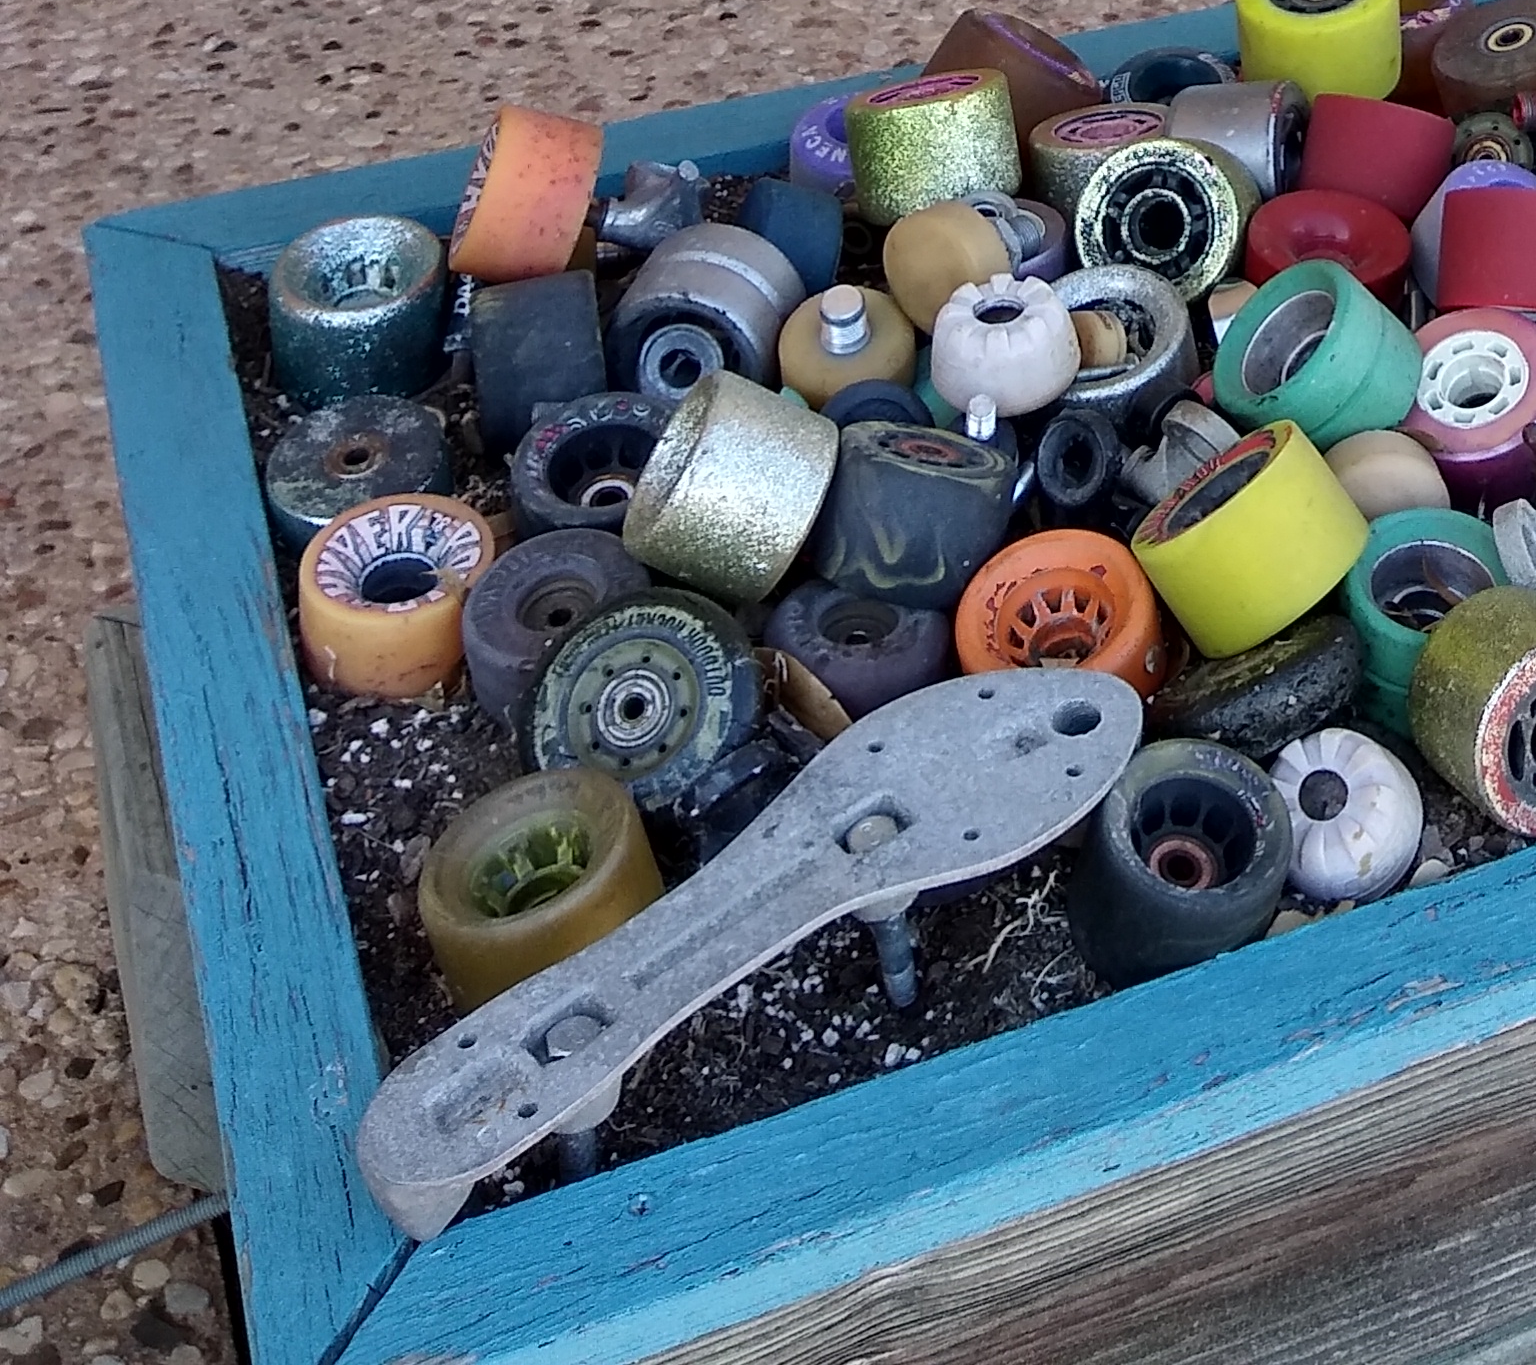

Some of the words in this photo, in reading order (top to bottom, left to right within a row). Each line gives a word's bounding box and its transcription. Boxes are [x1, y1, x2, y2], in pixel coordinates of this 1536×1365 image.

[801, 125, 848, 163] NECA
[627, 612, 688, 633] HOCKEY
[687, 626, 729, 698] OUTDOOR
